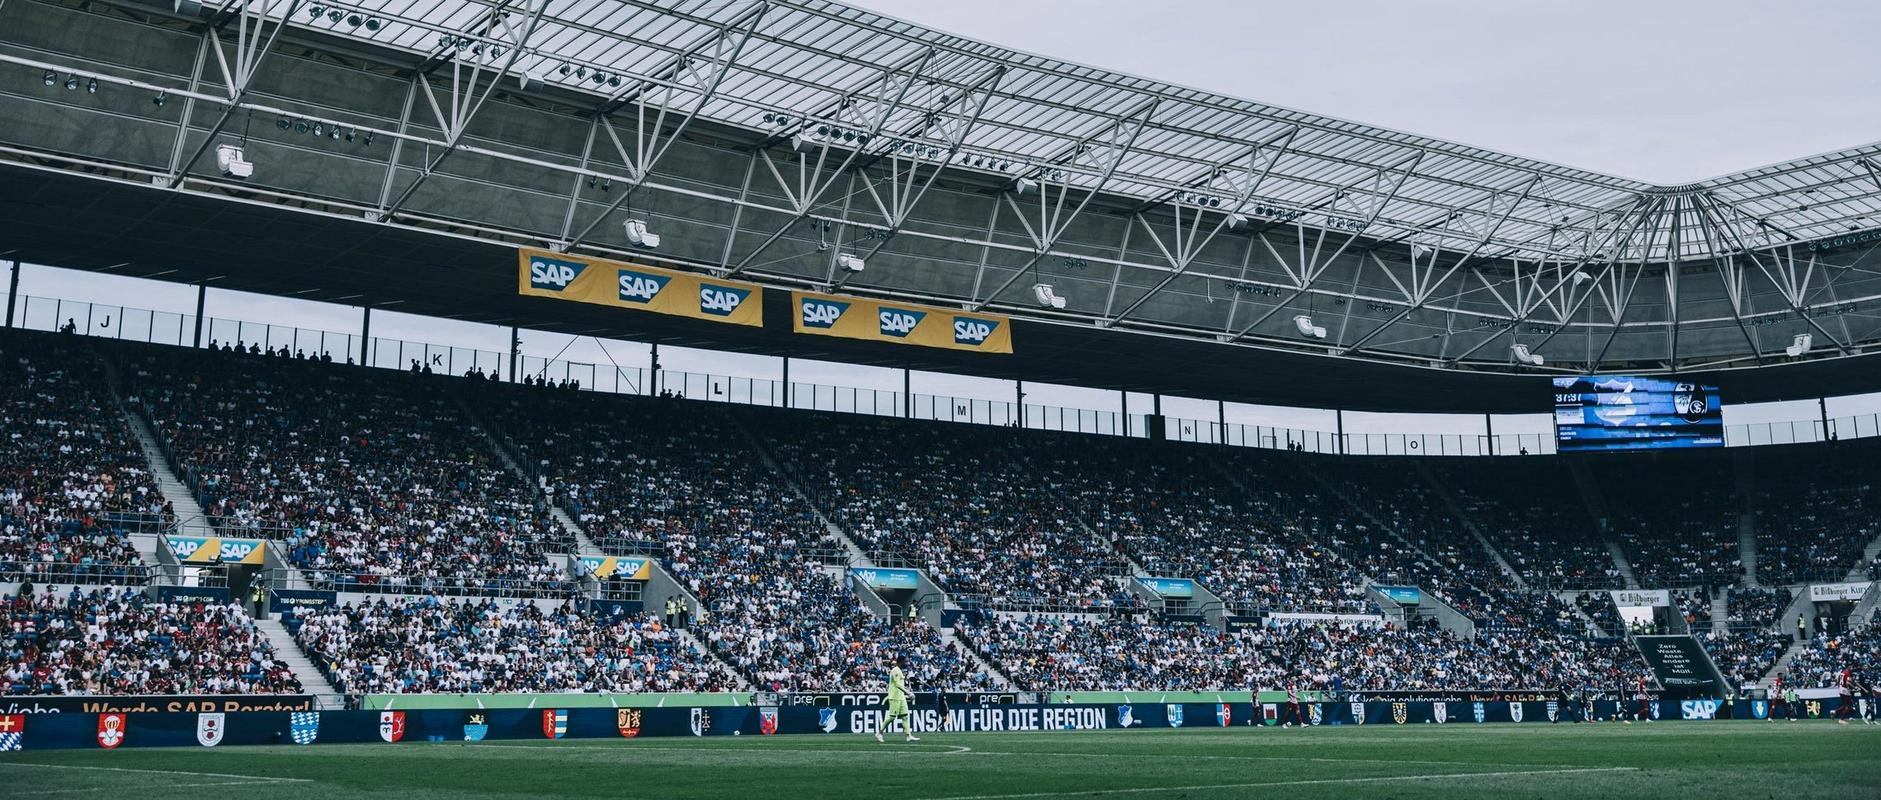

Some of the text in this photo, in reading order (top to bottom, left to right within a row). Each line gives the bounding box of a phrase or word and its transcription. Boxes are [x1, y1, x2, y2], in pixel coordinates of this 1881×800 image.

[531, 261, 575, 287] SAP
[619, 275, 660, 299] SAP
[700, 288, 740, 312] SAP
[100, 315, 110, 328] J
[803, 302, 840, 324] SAP
[880, 311, 916, 333] SAP
[954, 320, 990, 341] SAP
[432, 354, 443, 366] K
[714, 382, 723, 395] L
[957, 405, 967, 416] M
[1184, 425, 1191, 435] N
[221, 543, 252, 558] SAP
[585, 560, 600, 572] AP
[616, 561, 640, 575] SAP
[970, 704, 1003, 732] FÜR
[1008, 708, 1038, 731] DIE
[1043, 707, 1106, 730] REGION
[1681, 700, 1717, 720] SAP
